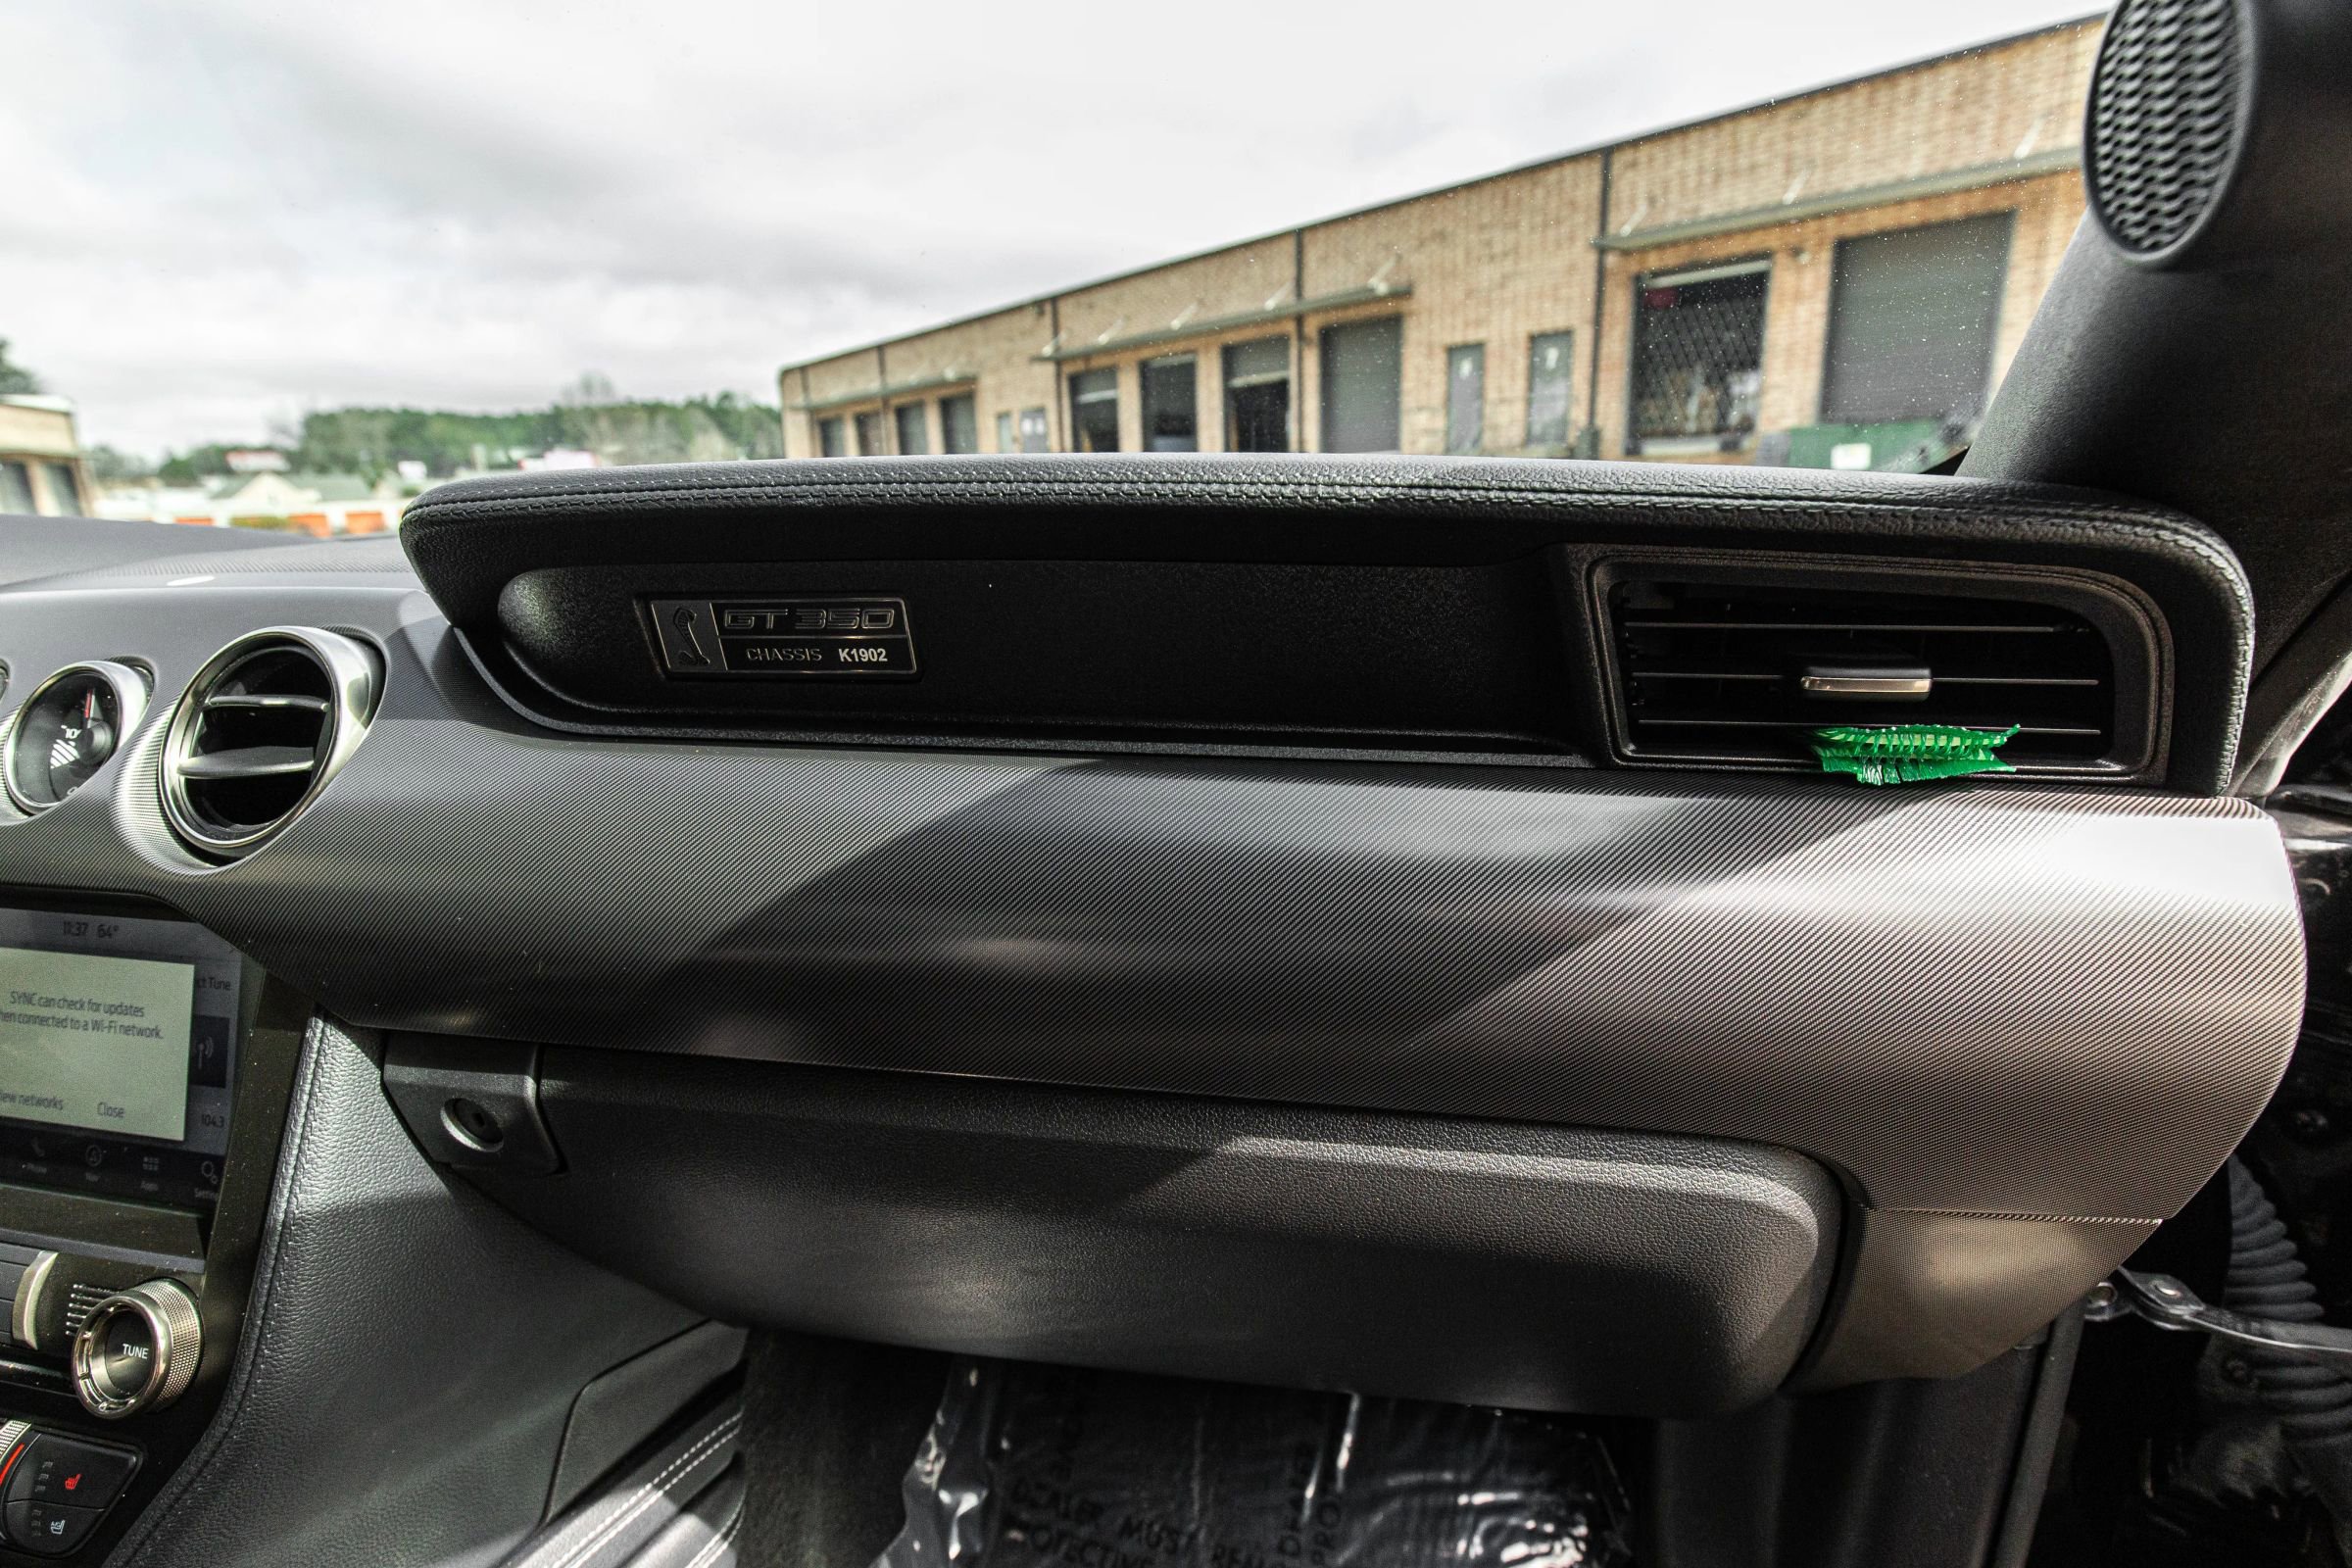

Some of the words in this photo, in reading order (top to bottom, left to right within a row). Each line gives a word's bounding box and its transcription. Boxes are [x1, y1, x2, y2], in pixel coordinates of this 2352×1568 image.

[724, 609, 789, 629] GT
[795, 609, 895, 629] 350
[746, 648, 822, 662] CHASSIS
[838, 648, 889, 662] K1902
[208, 976, 231, 991] Tune
[10, 990, 38, 1005] SYNC
[38, 996, 56, 1008] can
[57, 997, 86, 1011] check
[87, 998, 102, 1012] for
[102, 1002, 145, 1017] updates
[0, 1009, 17, 1023] hen
[18, 1012, 69, 1029] connected
[70, 1017, 80, 1030] to
[81, 1019, 89, 1032] a
[90, 1019, 118, 1035] Wi-Fi
[118, 1024, 164, 1040] network.
[19, 1094, 64, 1111] networks
[97, 1101, 125, 1118] Close
[122, 1343, 149, 1359] TUNE
